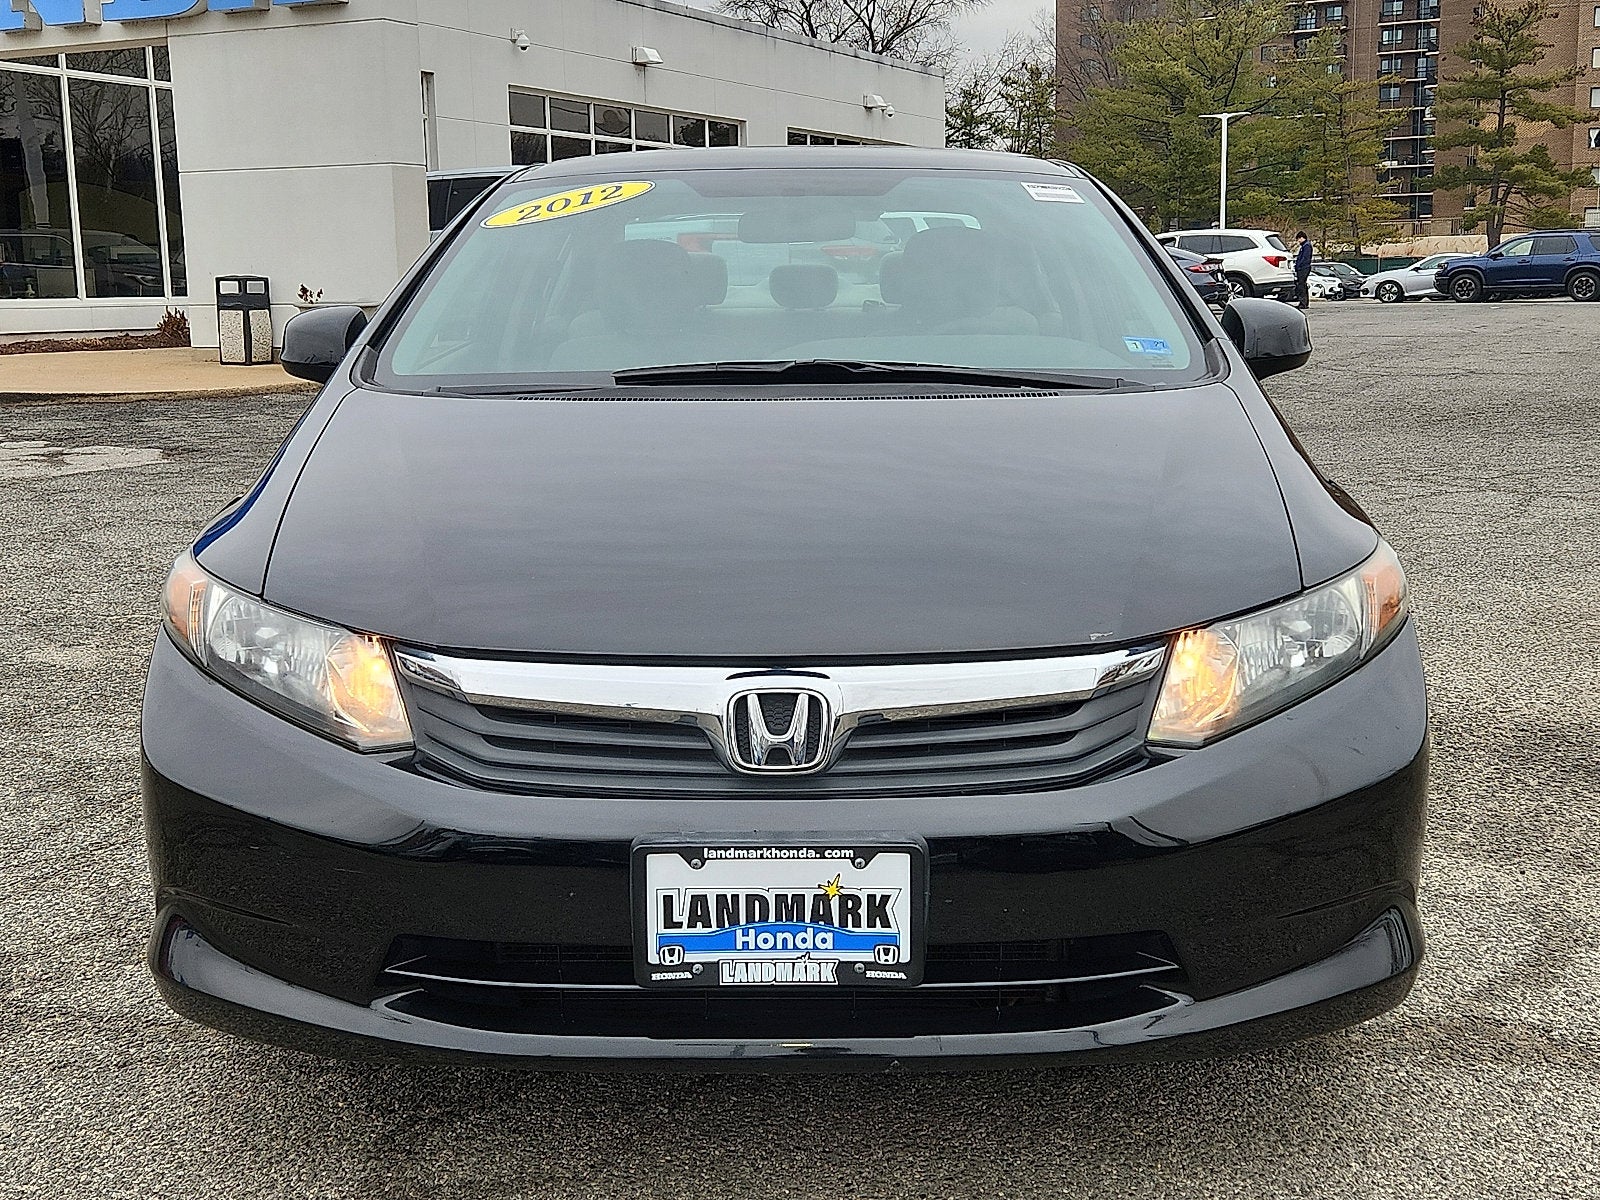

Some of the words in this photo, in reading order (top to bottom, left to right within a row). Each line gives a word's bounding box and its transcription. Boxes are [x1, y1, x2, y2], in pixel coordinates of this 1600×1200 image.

[516, 185, 623, 222] 2012
[662, 893, 893, 929] LANDMARK
[736, 927, 834, 950] Honda
[651, 972, 693, 981] HONDA
[722, 962, 835, 983] LANDMARK
[865, 970, 907, 980] HONDA
